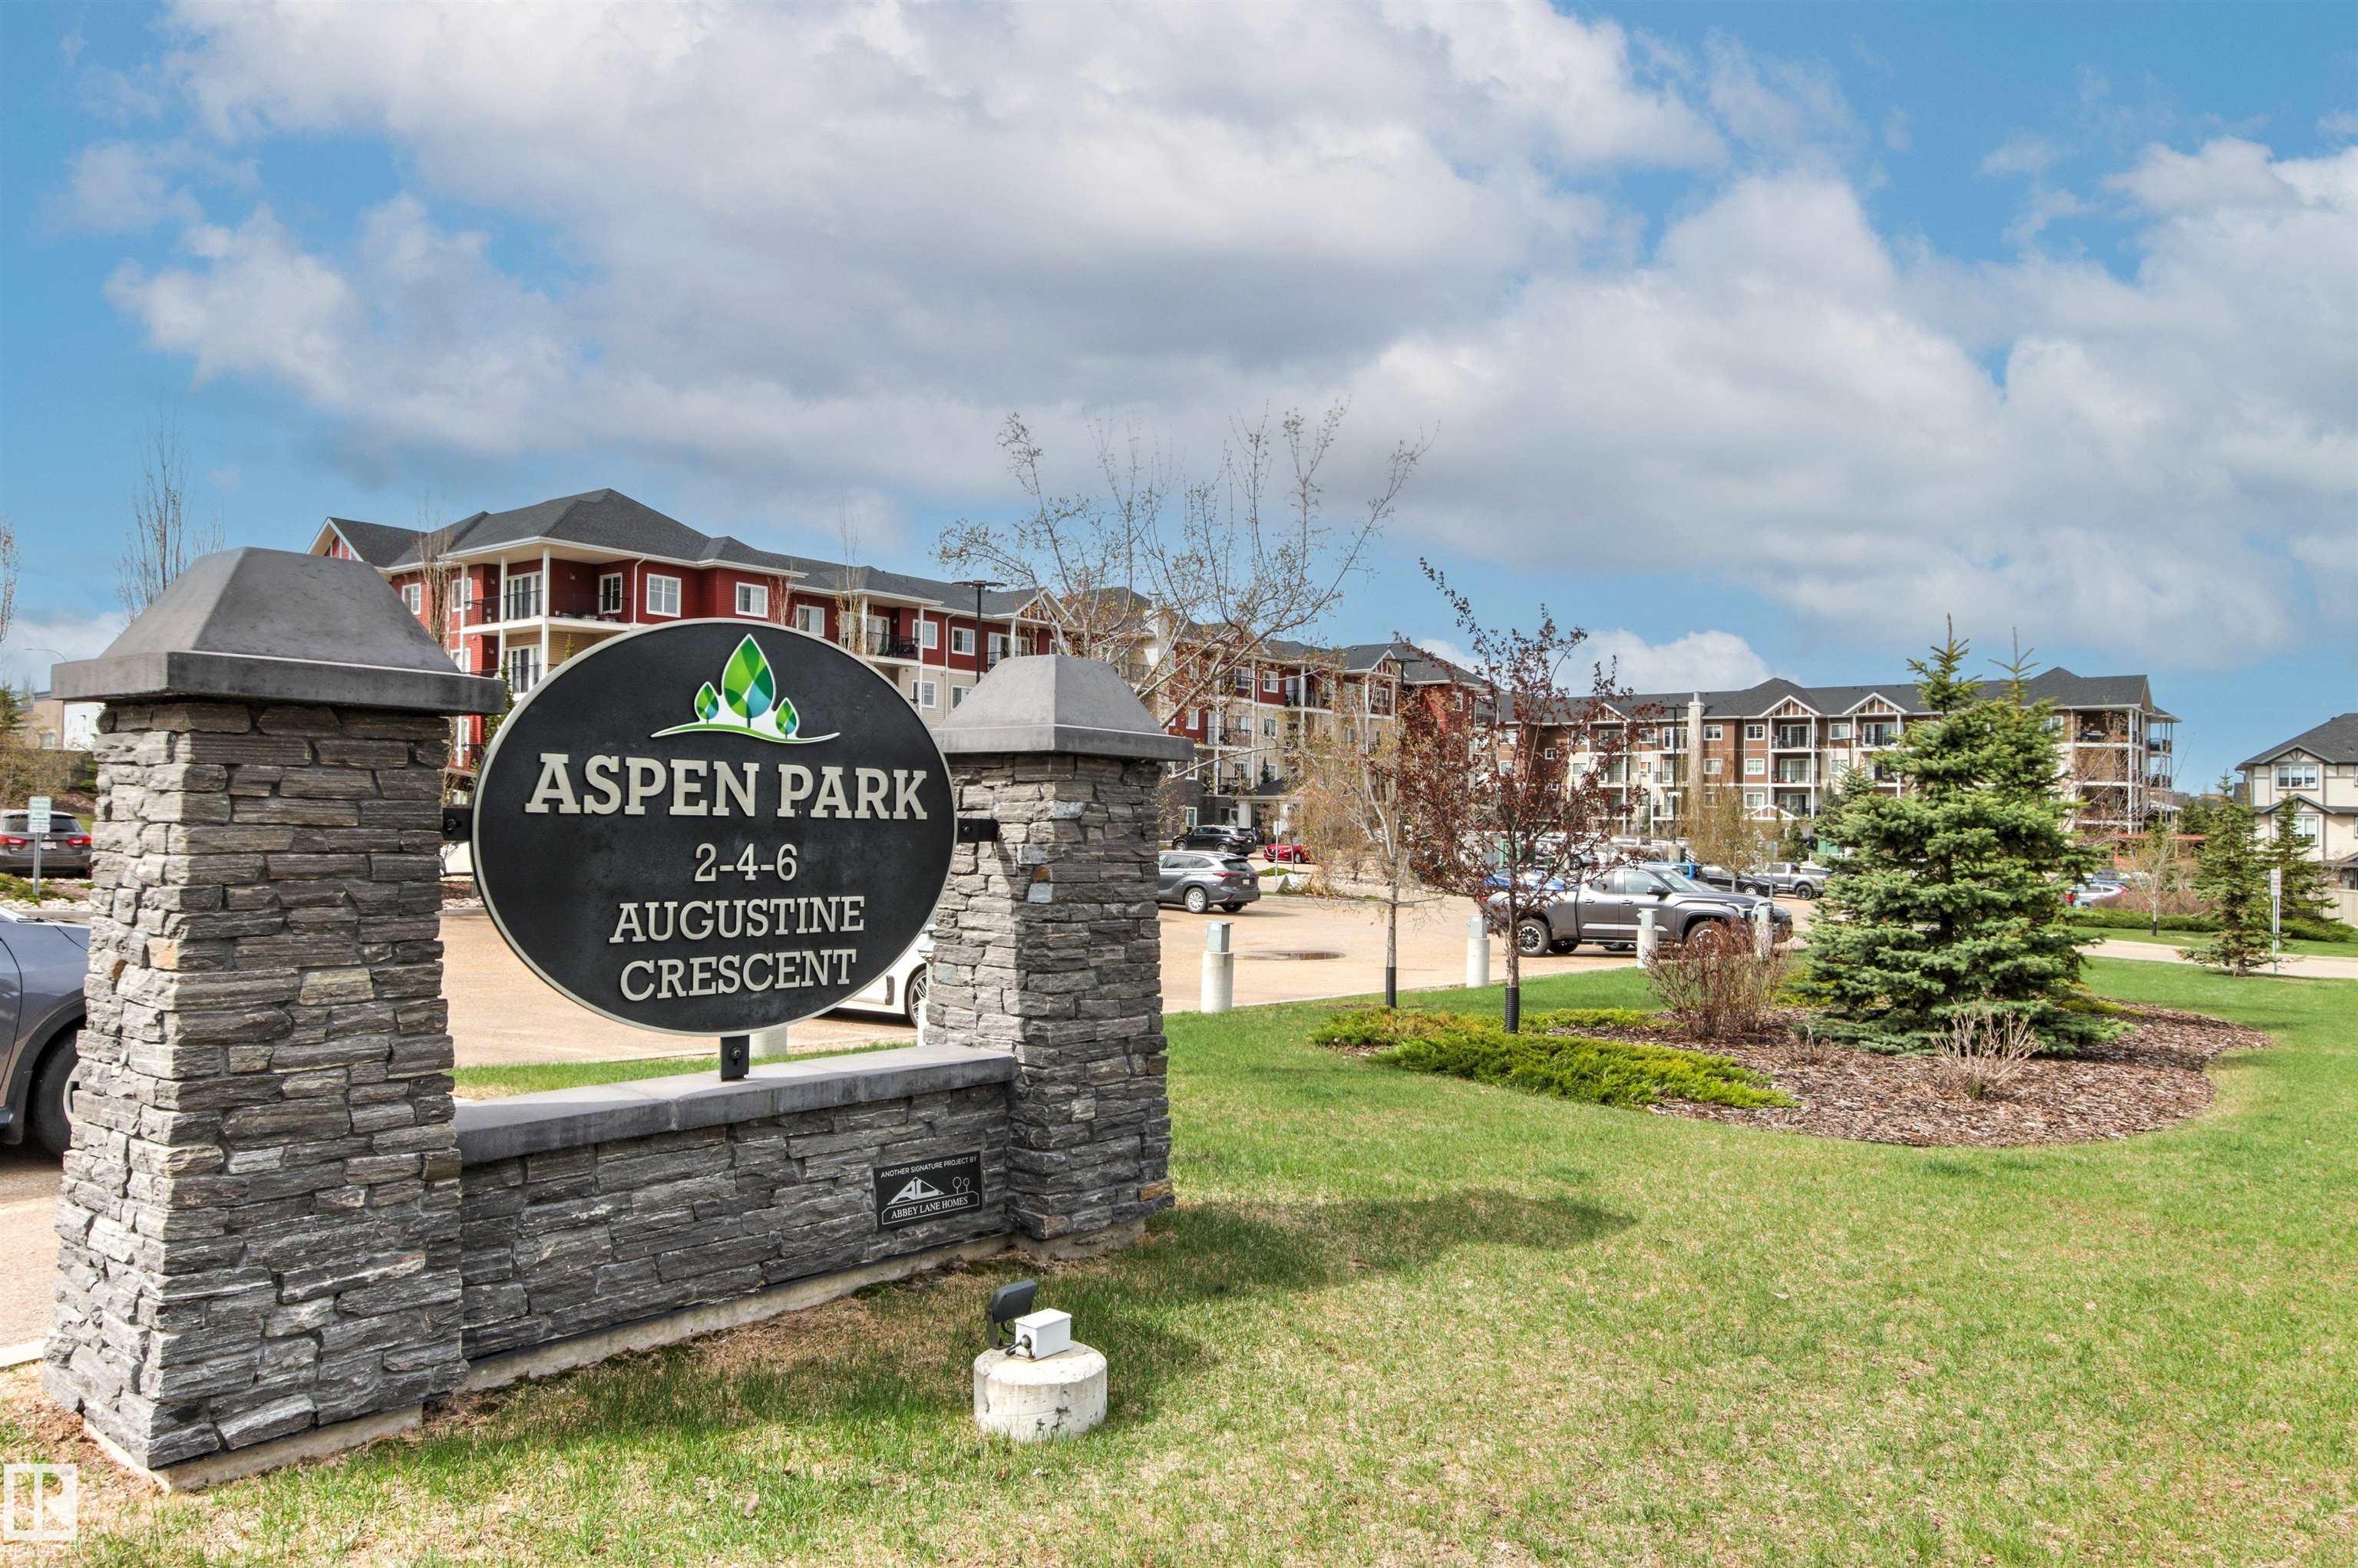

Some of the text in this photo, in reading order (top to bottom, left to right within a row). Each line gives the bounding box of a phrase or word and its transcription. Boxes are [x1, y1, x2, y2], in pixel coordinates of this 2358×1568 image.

[525, 753, 928, 820] ASPEN PARK
[694, 843, 798, 881] 2-4-6
[609, 896, 866, 943] AUGUSTINE
[620, 949, 857, 1001] CRESCENT
[880, 1168, 910, 1178] ANOTHER
[910, 1162, 943, 1173] SIGNATURE
[943, 1157, 969, 1167] PROJECT
[891, 1197, 969, 1219] ABBEY LANE HOMES
